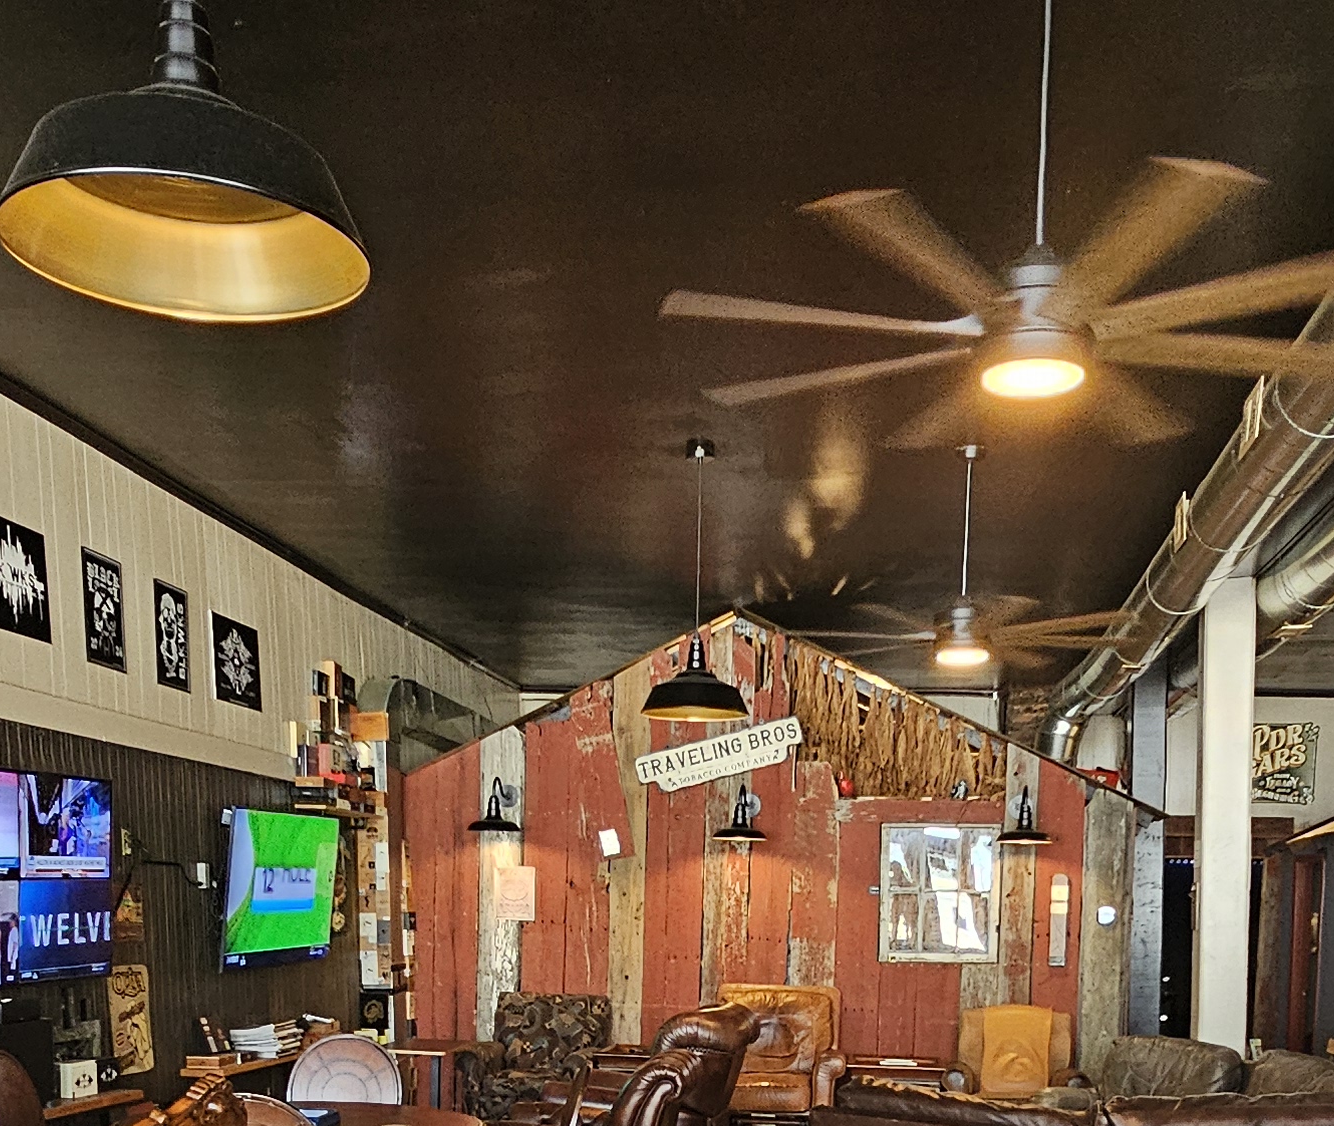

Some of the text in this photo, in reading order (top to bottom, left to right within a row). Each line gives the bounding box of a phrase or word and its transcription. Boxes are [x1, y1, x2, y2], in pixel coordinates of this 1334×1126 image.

[7, 561, 36, 587] WKS
[638, 722, 798, 779] TRAVELING BROS
[1253, 724, 1304, 763] PDR
[679, 754, 773, 785] TOBACCO COMPANY
